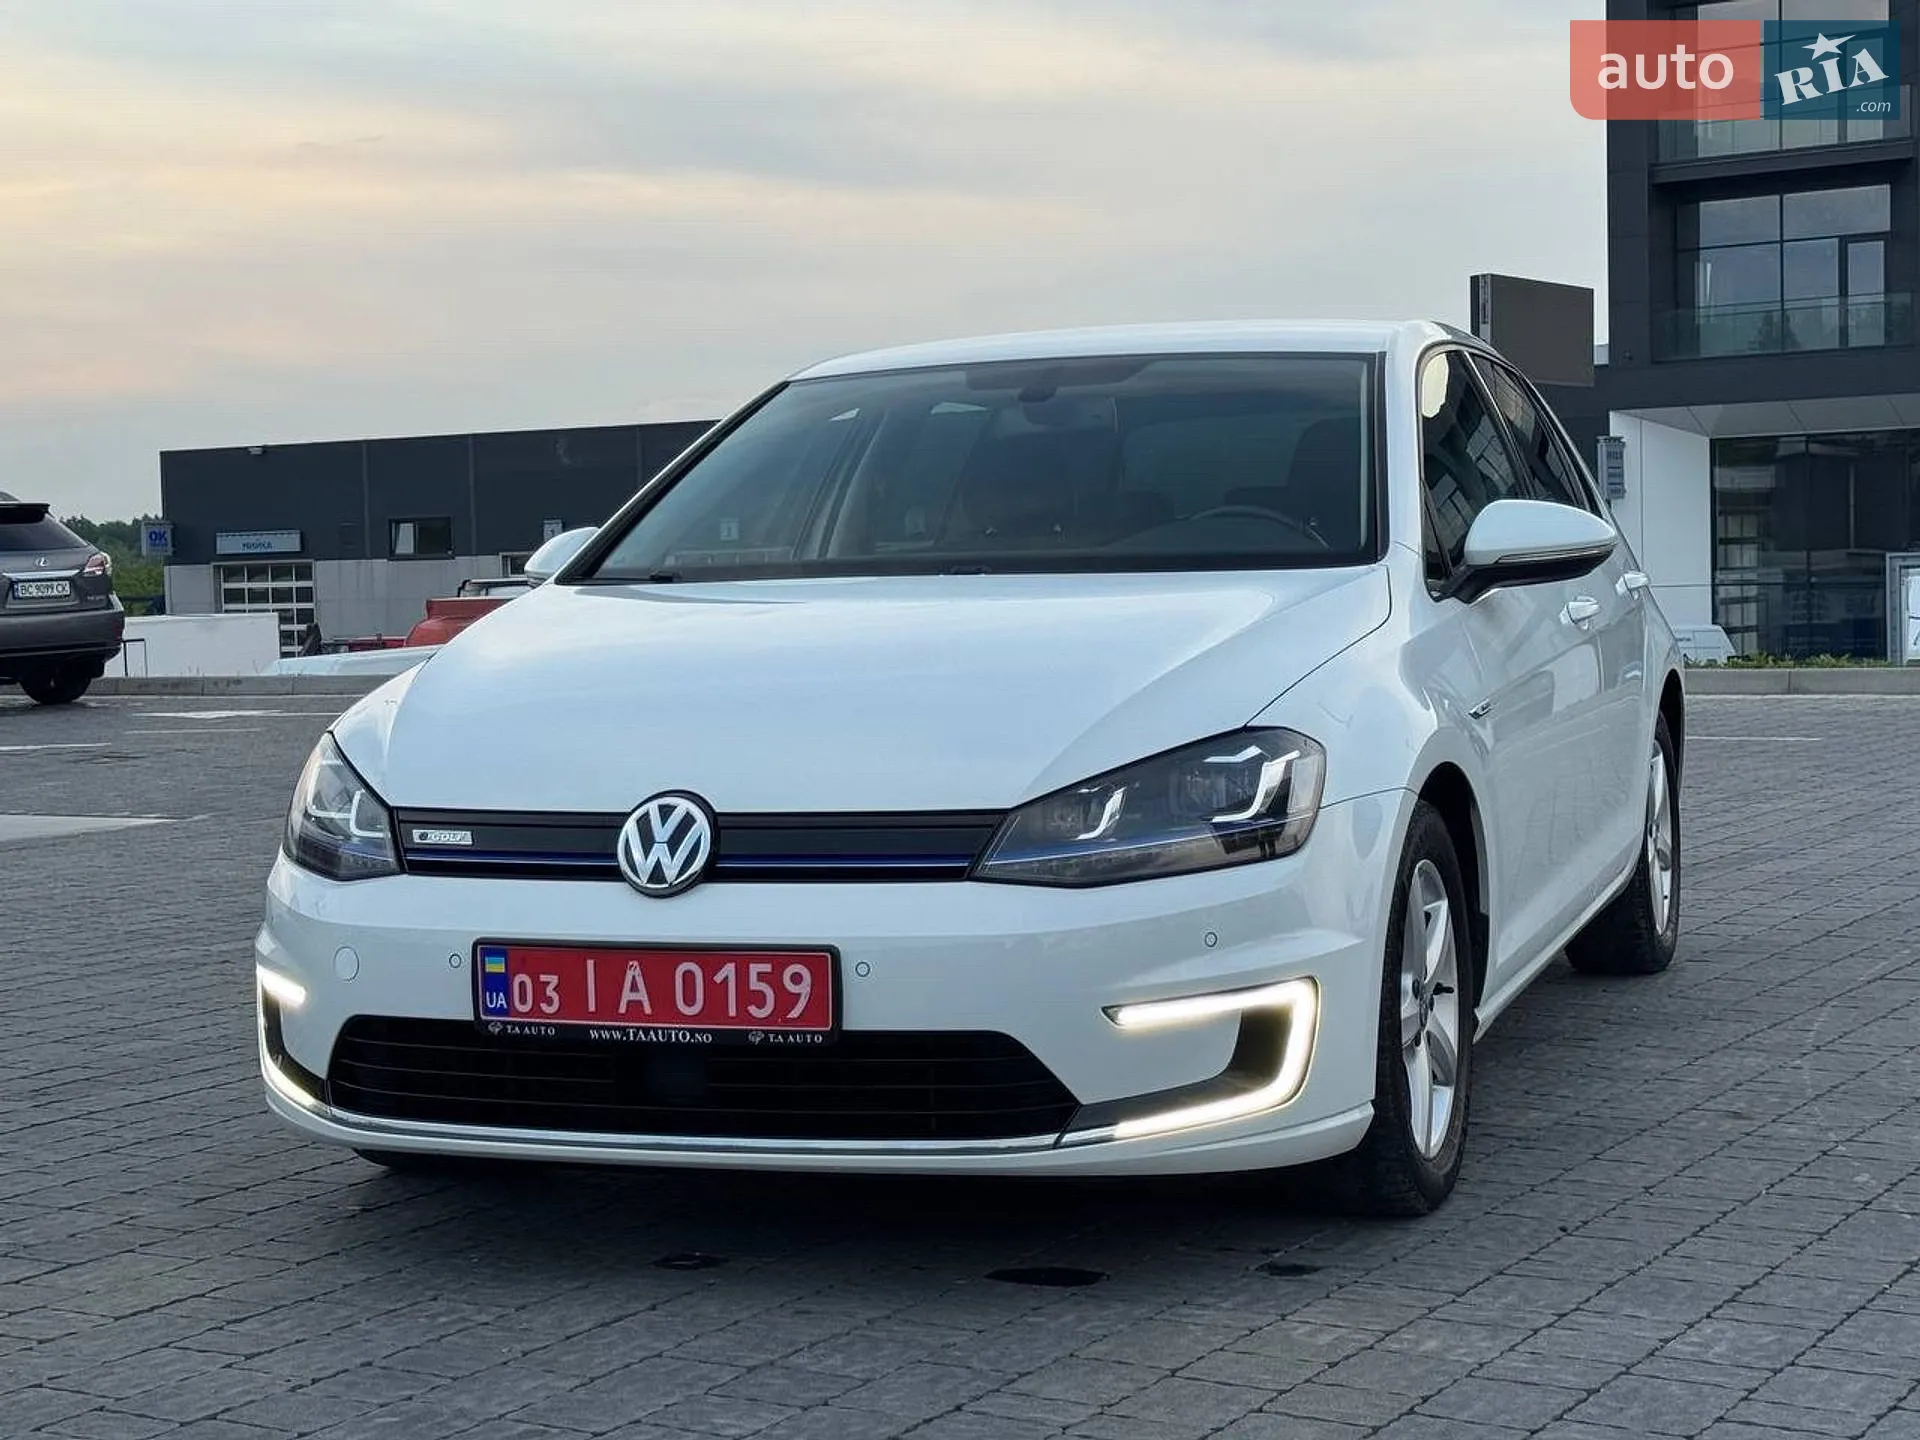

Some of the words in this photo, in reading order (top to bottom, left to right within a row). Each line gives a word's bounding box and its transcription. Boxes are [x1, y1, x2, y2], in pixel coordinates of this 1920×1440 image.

[512, 973, 560, 1014] 03
[675, 961, 812, 1019] 0159
[486, 992, 508, 1008] UA
[788, 1033, 823, 1044] AUTO
